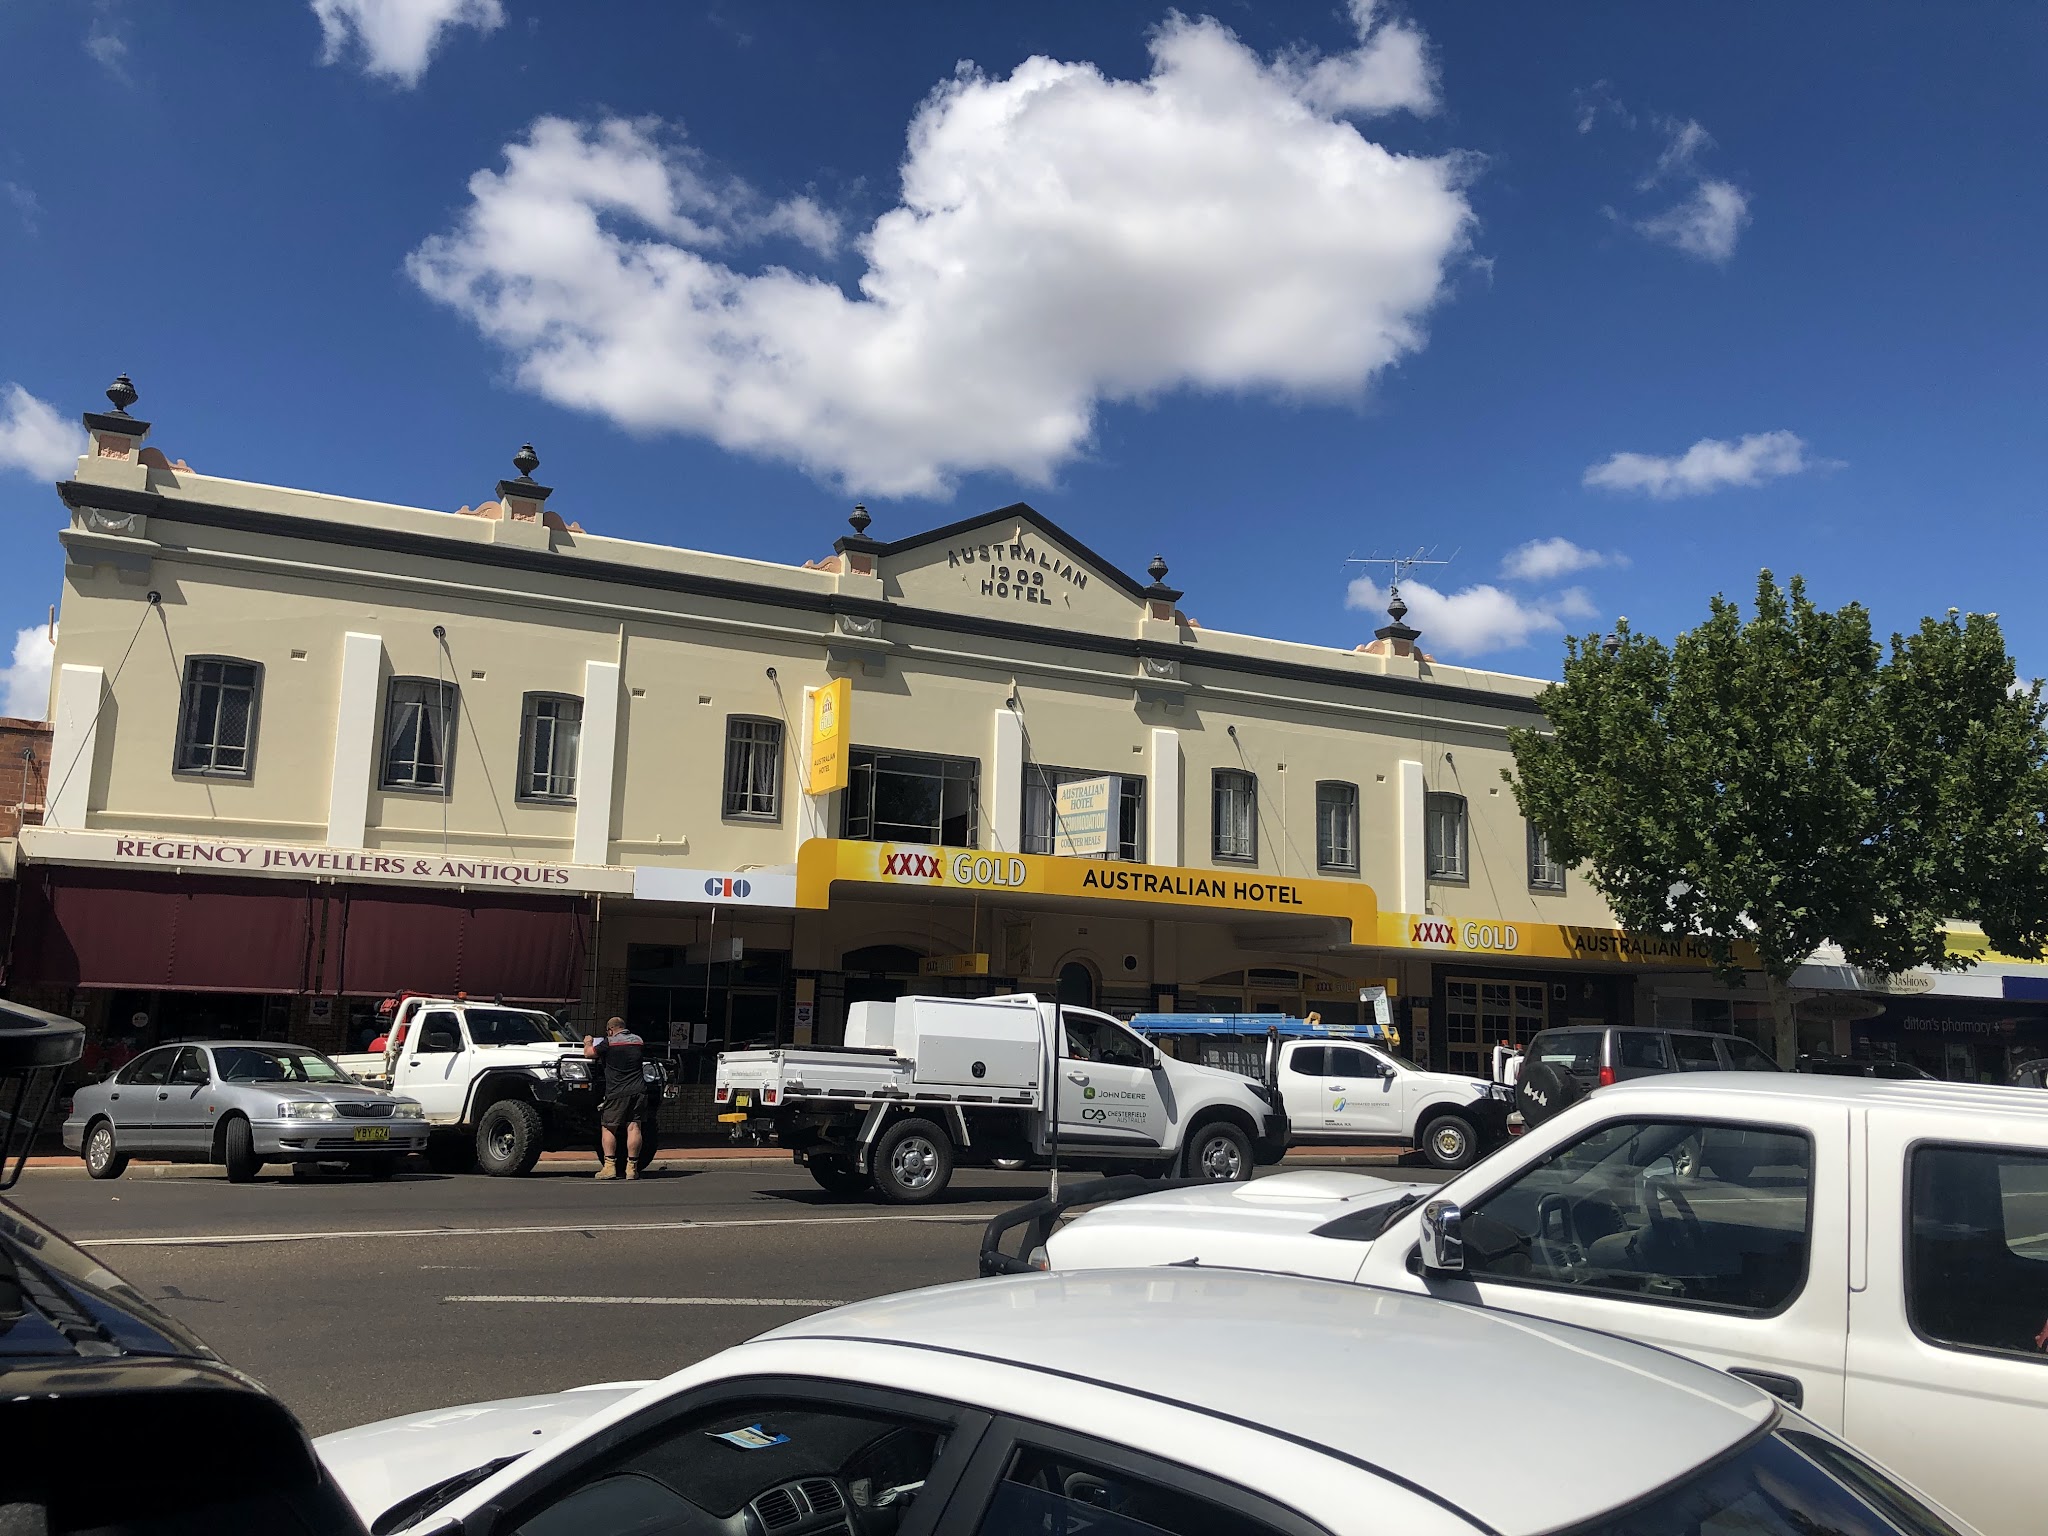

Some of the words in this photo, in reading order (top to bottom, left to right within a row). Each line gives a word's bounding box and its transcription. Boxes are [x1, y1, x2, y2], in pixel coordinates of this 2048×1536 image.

[948, 544, 1088, 590] AUSTRALIAN
[990, 564, 1044, 587] 1909
[981, 579, 1052, 605] HOTEL
[814, 752, 836, 766] AUSTRALIAN
[818, 764, 830, 775] HOTEL
[1061, 783, 1105, 801] AUSTRALIAN
[1070, 796, 1094, 811] HOTEL
[1084, 836, 1101, 846] MEALS
[116, 839, 253, 864] REGENCY
[260, 849, 406, 875] JEWELLERS
[412, 859, 432, 876] &
[438, 861, 570, 885] ANTIQUES
[704, 877, 751, 898] GIO
[882, 853, 943, 879] XXXX
[952, 852, 1027, 887] GOLD
[1082, 869, 1226, 899] AUSTRALIAN
[1233, 881, 1303, 905] HOTEL
[1411, 922, 1456, 945] XXXX
[1462, 921, 1519, 951] GOLD
[1575, 934, 1681, 957] AUSTRALIAN
[1942, 1017, 1991, 1036] pharmacy
[1098, 1090, 1120, 1099] JOHN
[1121, 1091, 1146, 1100] DEERE
